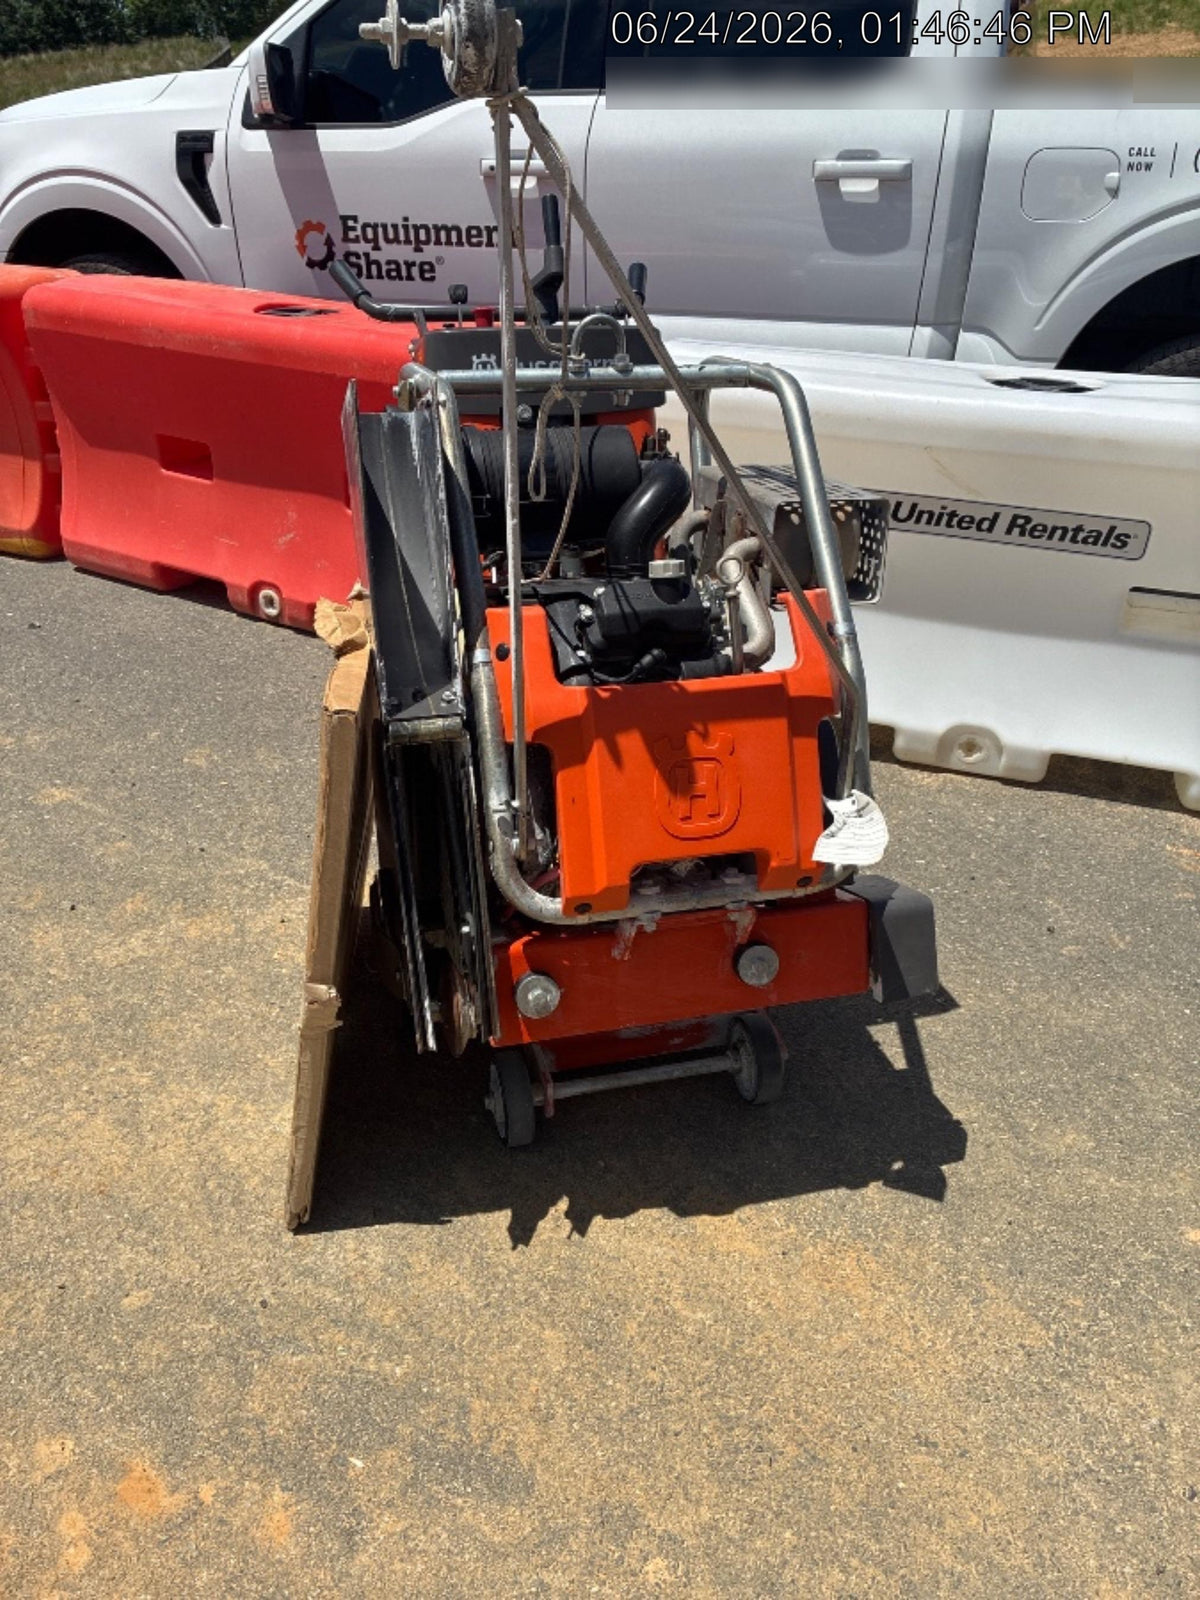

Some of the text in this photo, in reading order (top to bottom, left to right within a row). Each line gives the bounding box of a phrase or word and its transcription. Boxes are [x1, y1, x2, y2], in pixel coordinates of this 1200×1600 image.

[1128, 147, 1156, 157] CALL
[1127, 162, 1153, 172] NOW
[891, 500, 1131, 550] United Rentals
